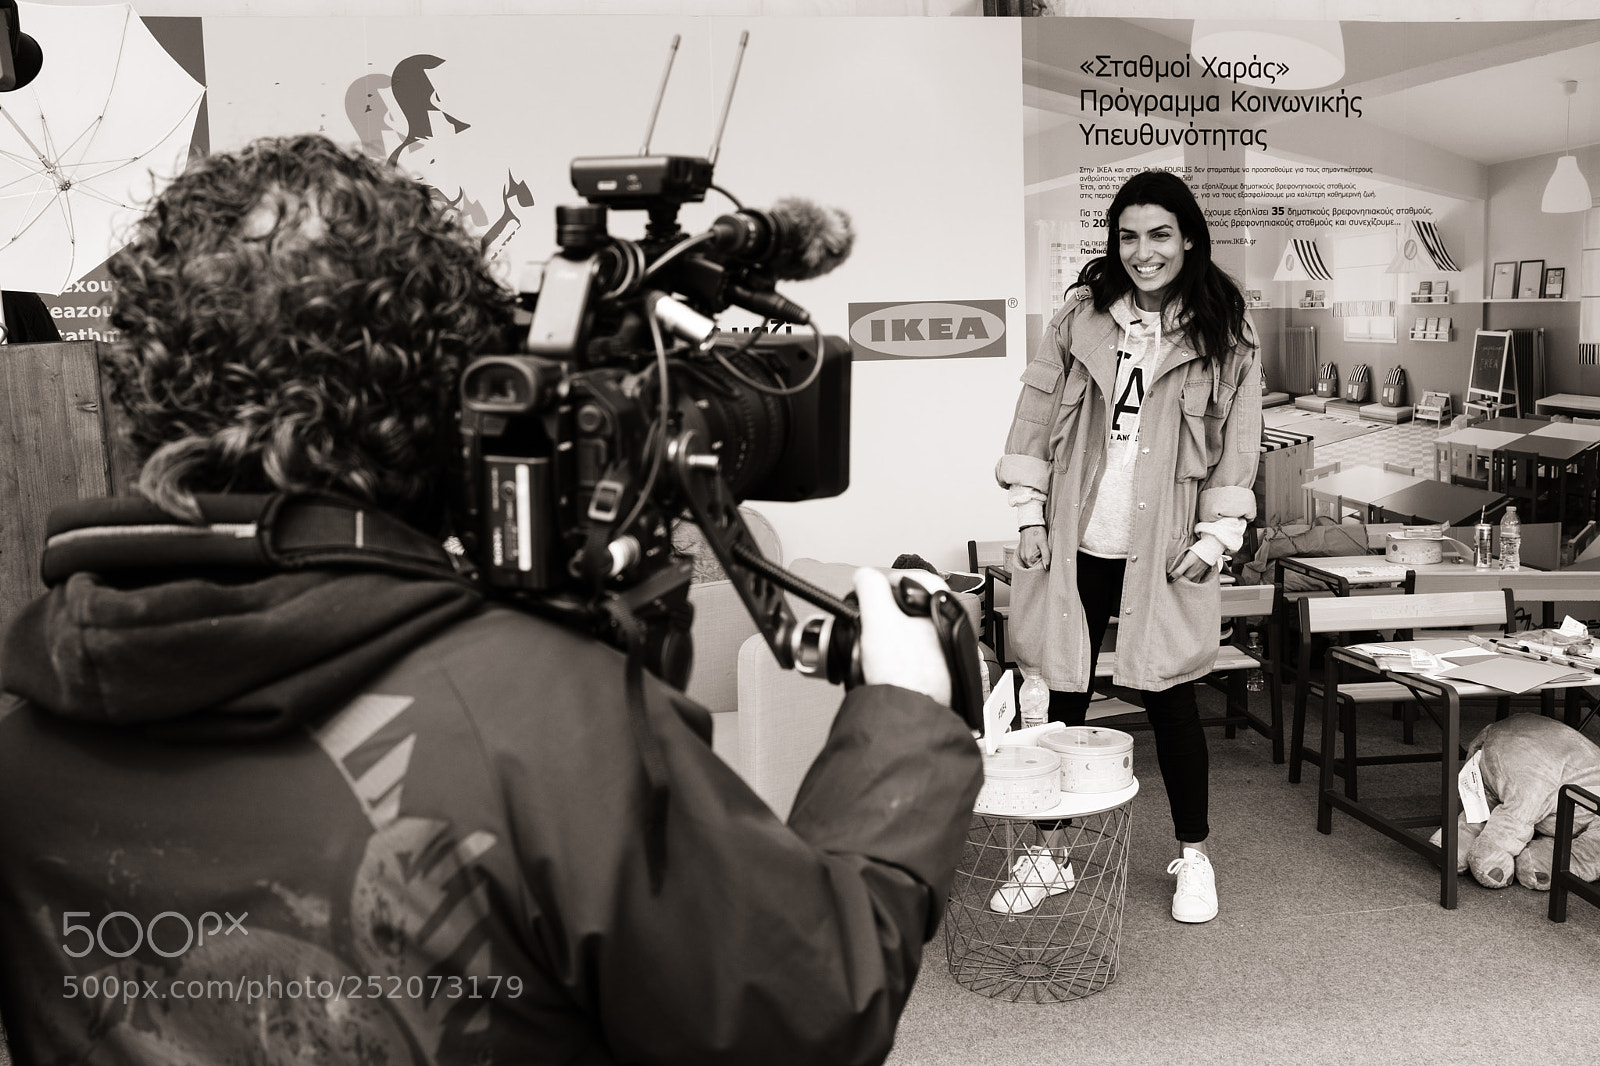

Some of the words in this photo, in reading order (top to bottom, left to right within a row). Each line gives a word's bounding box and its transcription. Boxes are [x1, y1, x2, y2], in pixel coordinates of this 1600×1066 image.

[1079, 54, 1191, 83] «Σταθμοί
[1201, 54, 1290, 84] Χαράς»
[1080, 87, 1220, 117] Πρόγραμμα
[1231, 88, 1362, 118] Κοινωνικής
[1079, 121, 1268, 151] Υπευθυνότητας
[1079, 166, 1094, 175] Στην
[1251, 166, 1293, 175] προσπαθούμε
[1295, 167, 1304, 175] για
[1321, 166, 1373, 175] σημαντικότερους
[1079, 174, 1116, 183] ανθρώπους
[1097, 183, 1110, 191] από
[1239, 182, 1275, 191] δημοτικούς
[1326, 182, 1356, 191] σταθμούς
[1080, 209, 1091, 217] Για
[1203, 208, 1232, 219] έχουμε
[1233, 208, 1269, 217] εξοπλίσει
[1271, 206, 1285, 216] 35
[1287, 207, 1330, 218] δημοτικούς
[1332, 207, 1394, 218] βρεφονηπιακούς
[1395, 206, 1433, 217] σταθμούς.
[1080, 220, 1090, 228] Το
[1230, 218, 1294, 229] βρεφονηπιακούς
[1295, 218, 1333, 228] σταθμούς
[1216, 238, 1256, 246] www.IKEA.gr
[870, 316, 990, 342] IKEA
